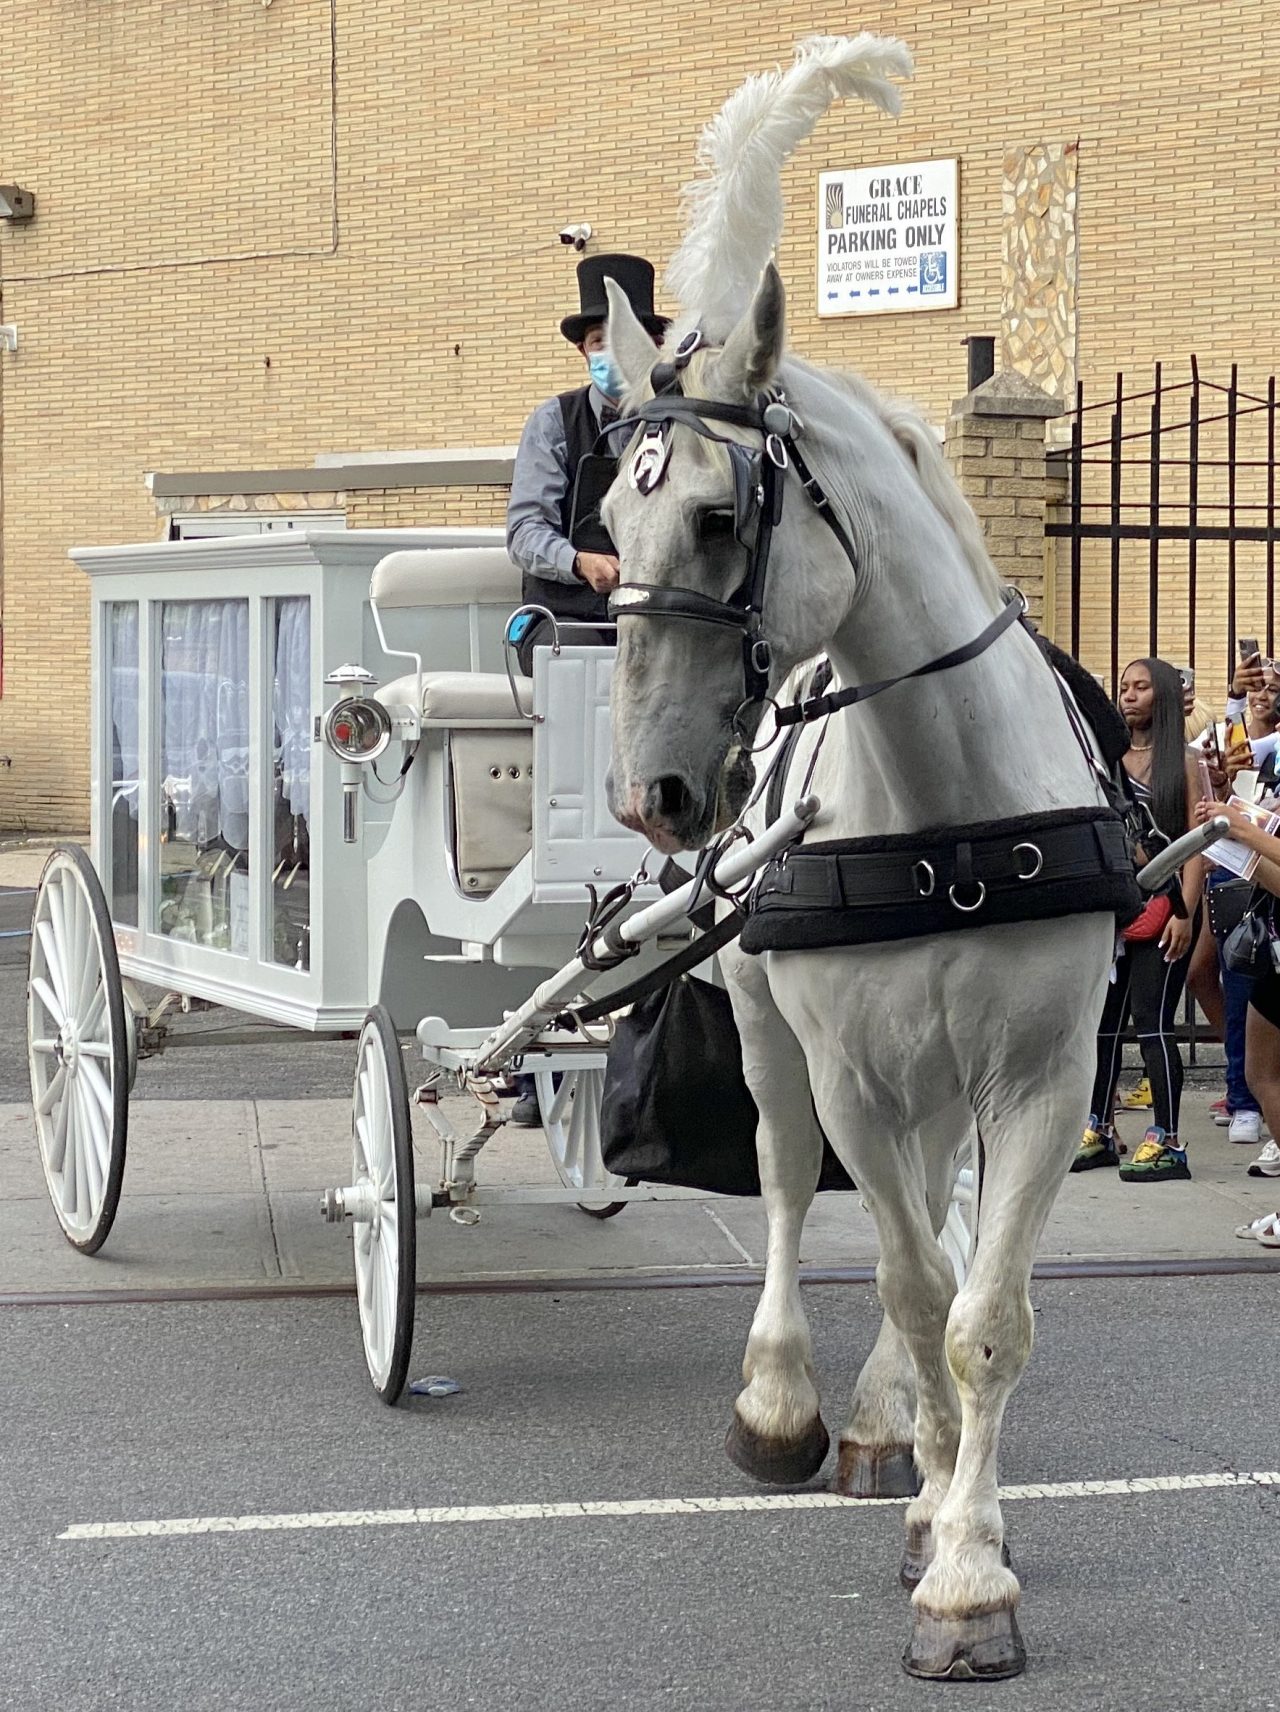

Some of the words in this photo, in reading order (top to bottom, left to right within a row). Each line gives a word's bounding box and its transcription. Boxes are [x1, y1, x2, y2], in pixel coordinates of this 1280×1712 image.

[869, 175, 923, 199] GRACE
[846, 202, 892, 225] FUNERAL
[897, 196, 947, 220] CHAPELS
[828, 228, 897, 255] PARKING
[905, 224, 945, 248] ONLY
[826, 272, 843, 284] AWAY
[845, 273, 853, 282] AT
[855, 270, 884, 281] OWNERS
[887, 267, 917, 279] EXPENSE
[827, 260, 862, 272] VIOLATORS
[864, 259, 880, 269] WILL
[882, 258, 892, 268] BE
[894, 256, 917, 267] TOWED
